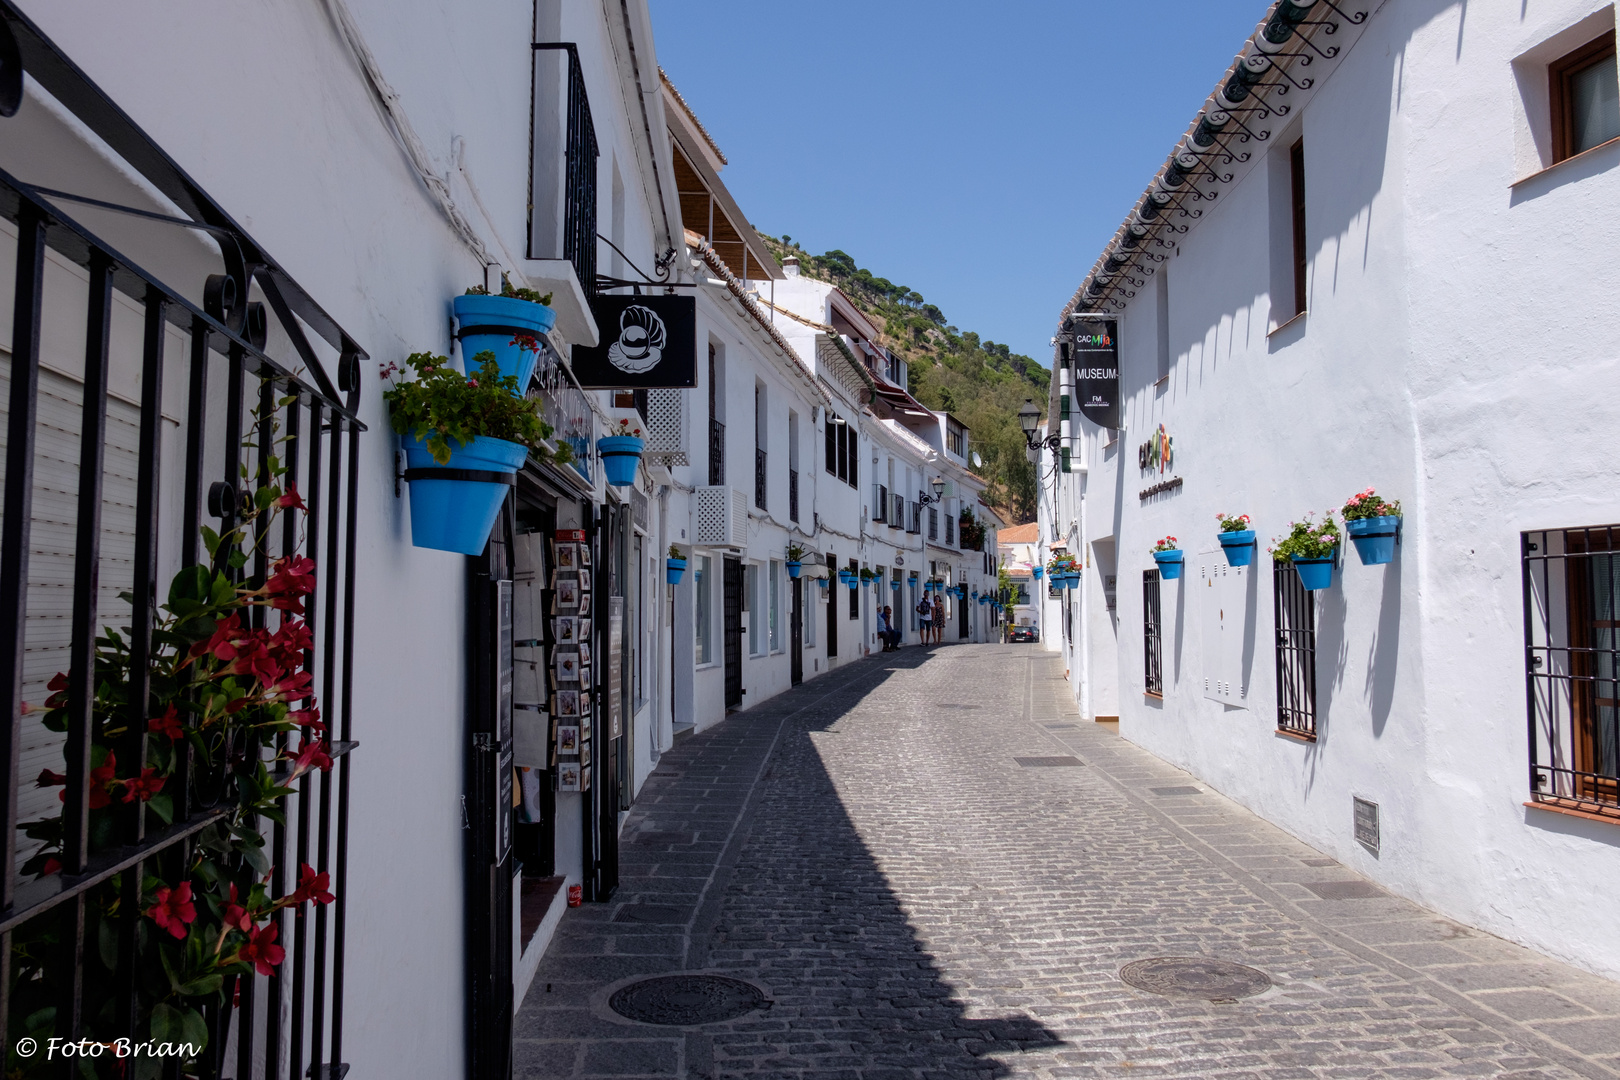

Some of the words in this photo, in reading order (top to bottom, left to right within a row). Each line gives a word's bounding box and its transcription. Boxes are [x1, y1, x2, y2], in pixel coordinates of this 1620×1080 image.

[1077, 334, 1091, 343] CAC
[1091, 334, 1114, 348] Mijas
[1077, 368, 1116, 380] MUSEUM
